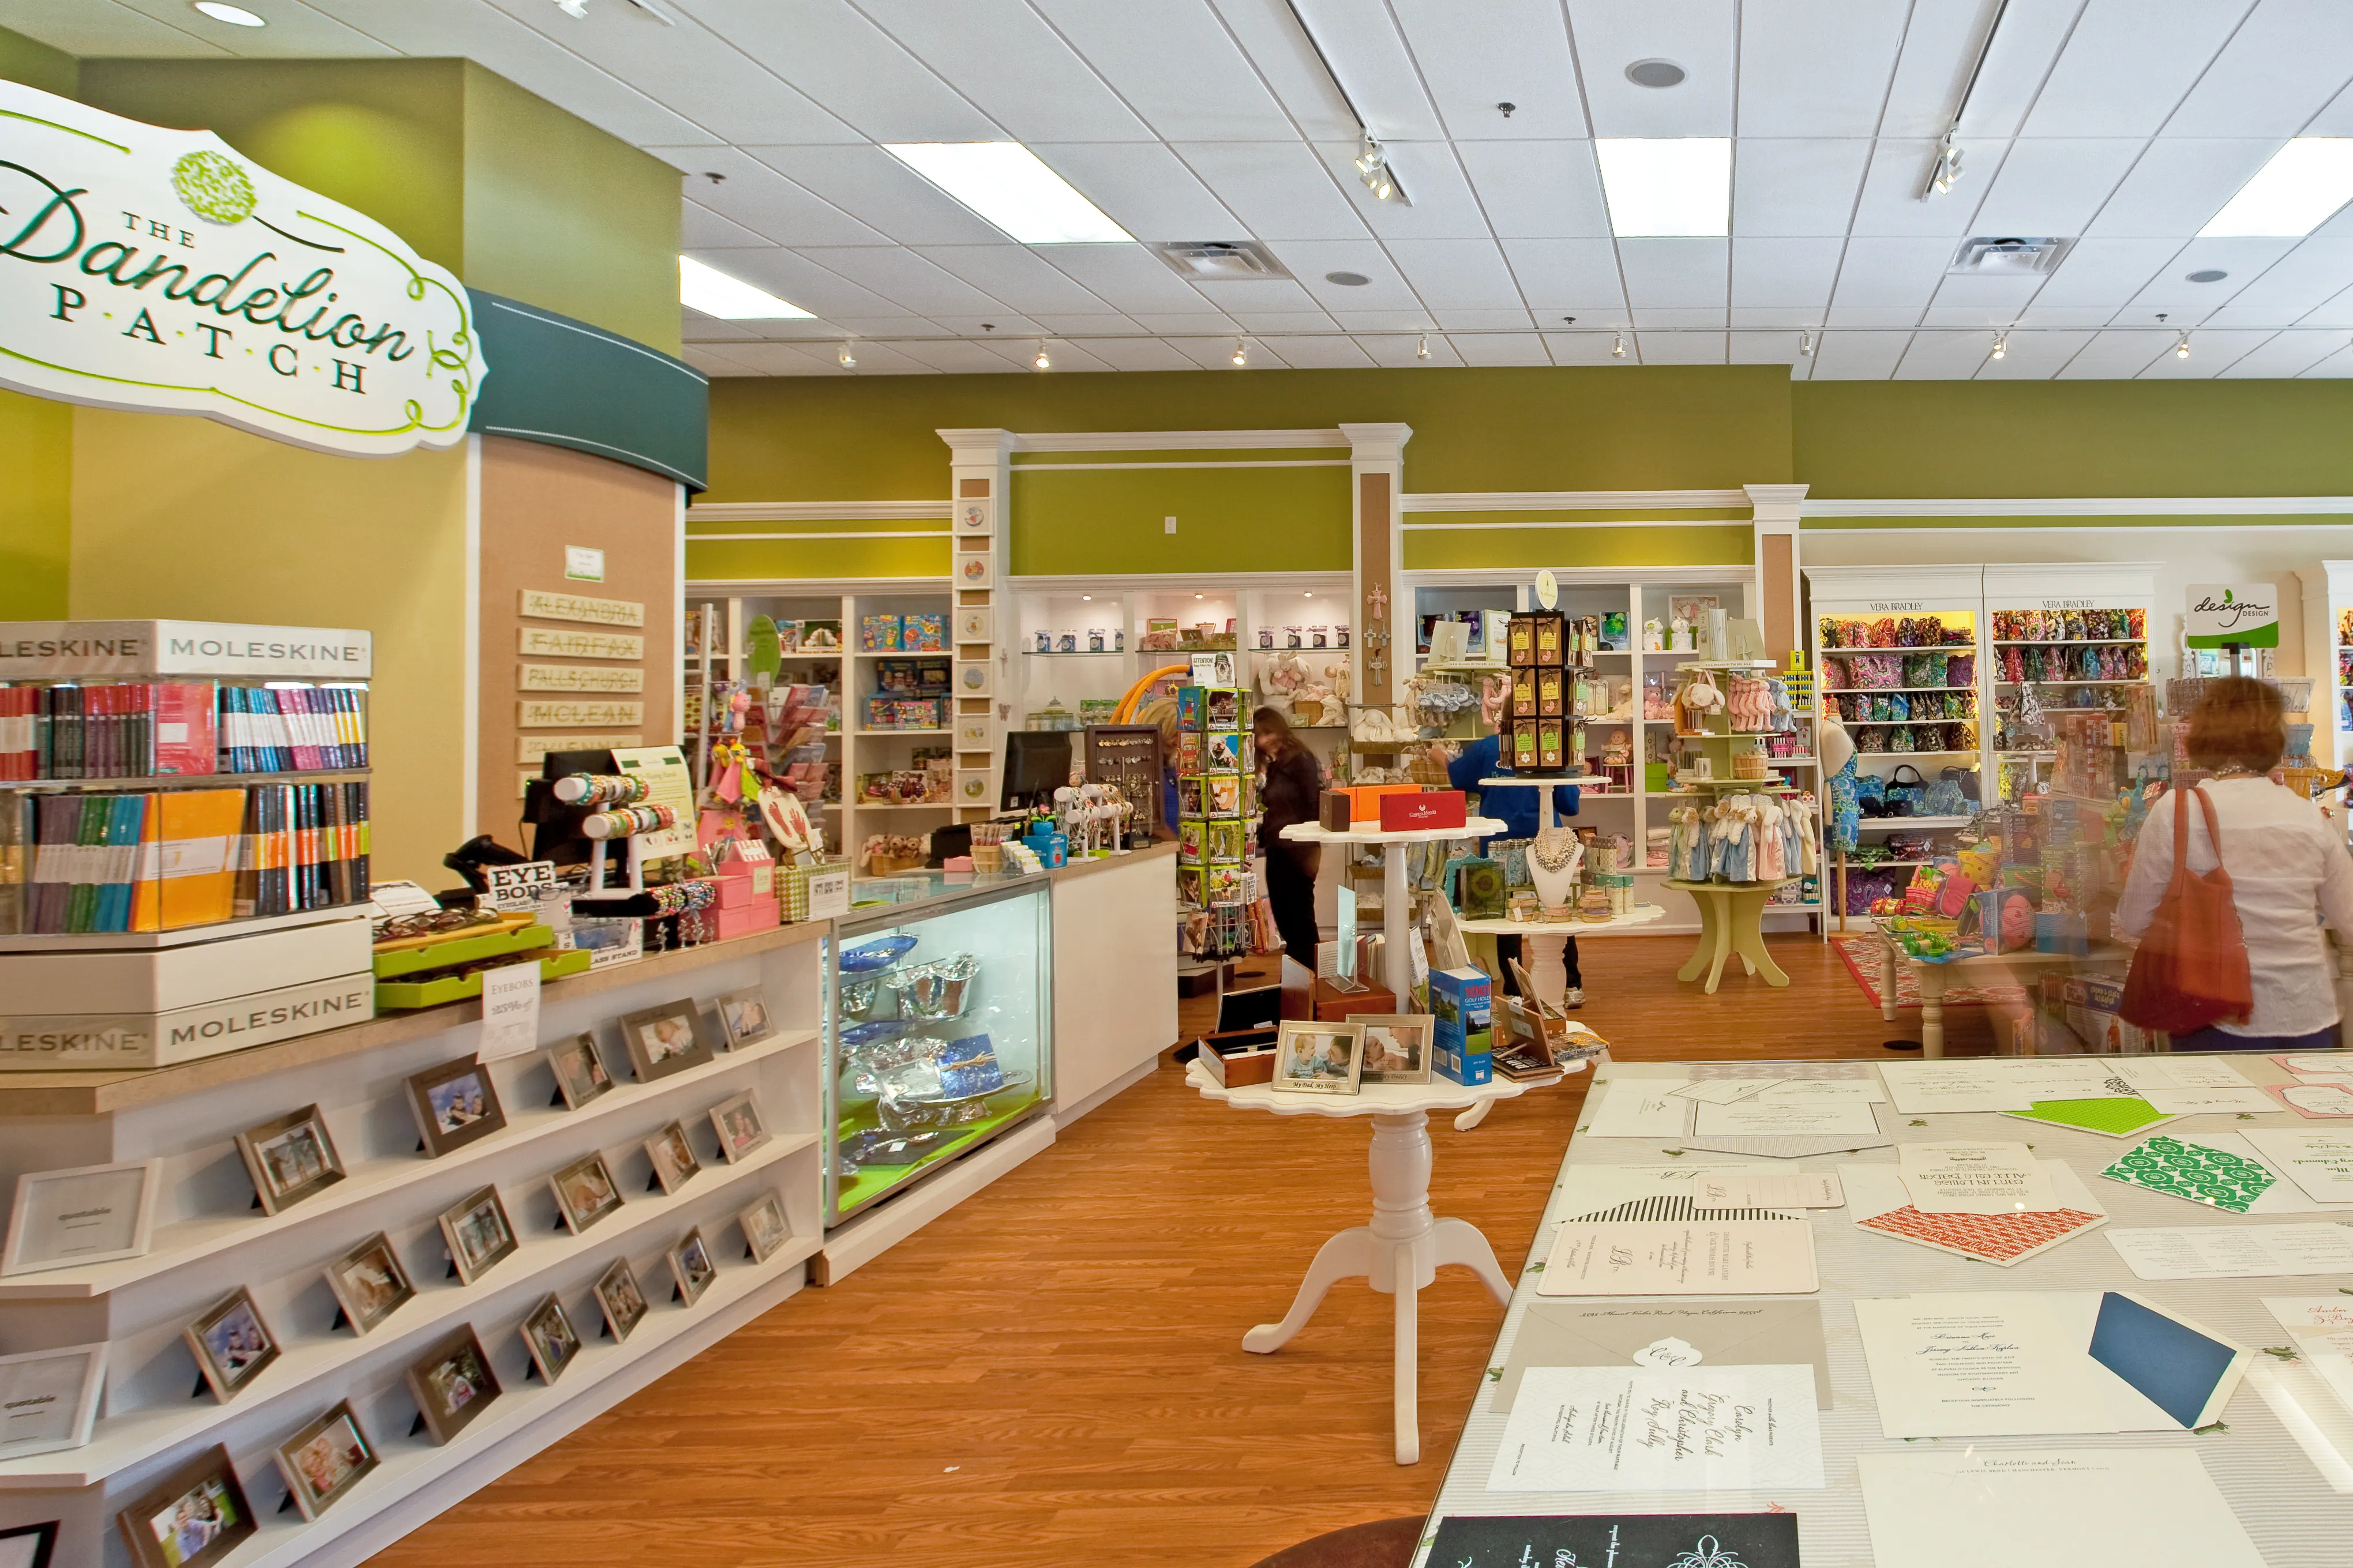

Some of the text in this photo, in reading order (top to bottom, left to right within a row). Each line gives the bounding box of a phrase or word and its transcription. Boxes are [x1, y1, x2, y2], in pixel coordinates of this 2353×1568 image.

[121, 210, 196, 249] THE
[0, 160, 415, 362] Dandelion
[1892, 603, 1923, 611] BRADLEY
[2194, 597, 2270, 627] design
[171, 638, 359, 661] MOLESKINE
[492, 865, 550, 887] EYE
[491, 979, 533, 995] EYEBOBS
[1465, 984, 1491, 998] 1001
[170, 992, 362, 1046] MOLESKINE
[1641, 1398, 1675, 1417] Roy
[1667, 1389, 1699, 1462] and Christopher
[1697, 1393, 1730, 1457] Gregory Clark
[1724, 1405, 1755, 1442] Carolyn
